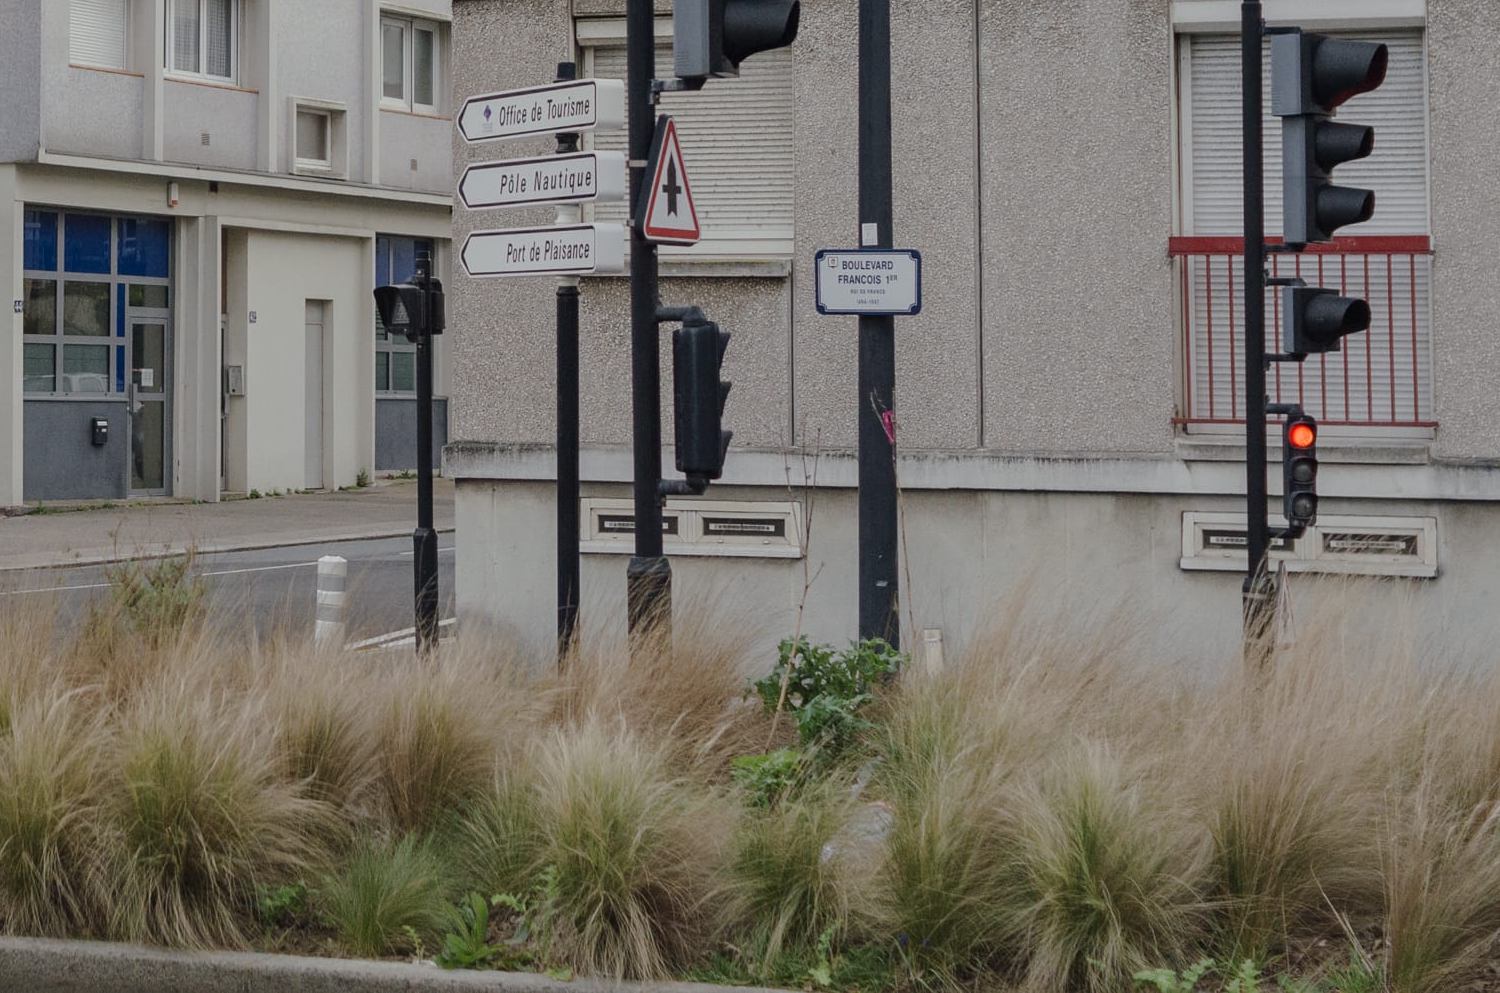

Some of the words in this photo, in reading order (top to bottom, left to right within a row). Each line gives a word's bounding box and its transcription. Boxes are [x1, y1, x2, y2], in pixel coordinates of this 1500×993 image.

[499, 105, 527, 127] Office
[531, 102, 542, 122] de
[547, 96, 590, 120] Tourisme
[499, 174, 526, 195] Pôle
[534, 168, 592, 193] Nautique
[506, 242, 525, 263] Port
[529, 241, 540, 262] de
[544, 239, 590, 261] Plaisance
[842, 261, 893, 270] BOULEVARD
[838, 275, 881, 284] FRANCOIS
